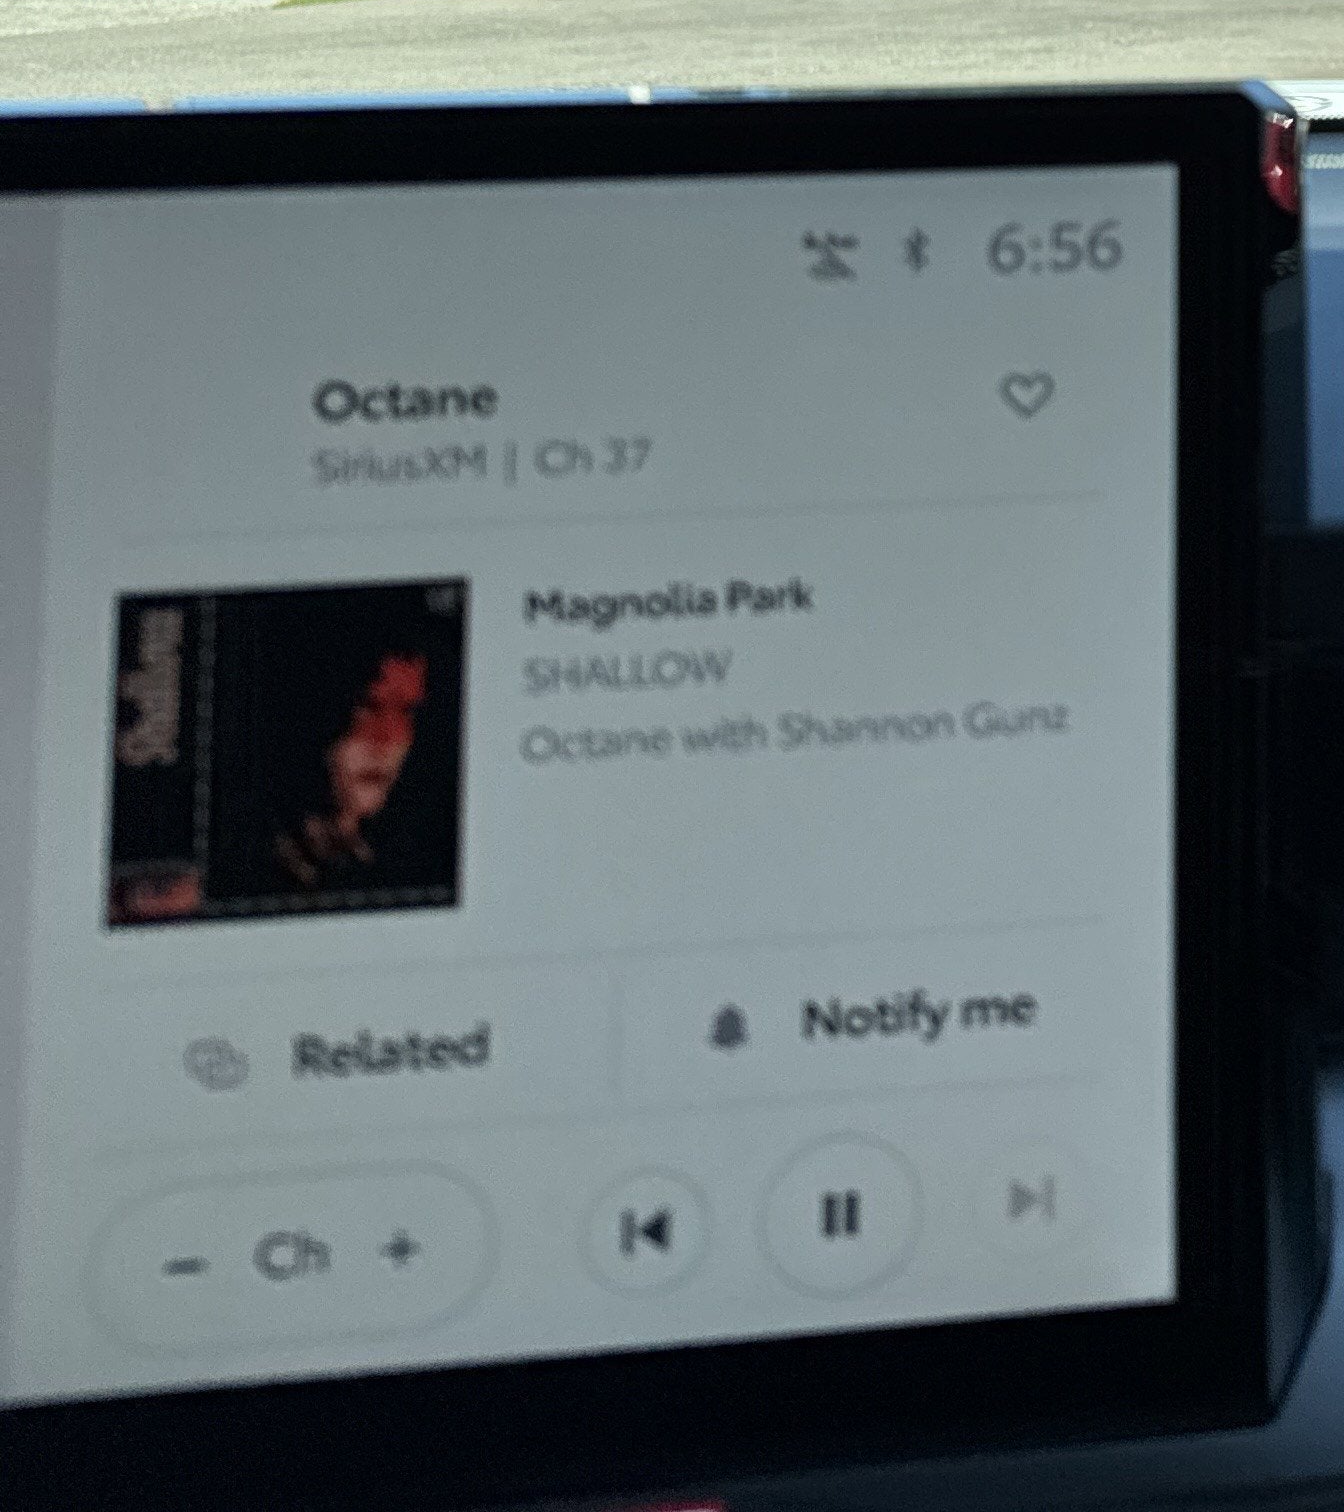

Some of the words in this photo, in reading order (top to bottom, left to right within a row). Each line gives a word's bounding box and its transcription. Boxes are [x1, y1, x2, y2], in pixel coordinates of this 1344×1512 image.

[987, 218, 1122, 276] 6:56
[312, 378, 499, 422] Octane
[310, 443, 486, 485] SiriusXM
[534, 436, 592, 477] Ch
[603, 436, 651, 474] 37
[522, 582, 717, 631] Magnolia
[726, 577, 814, 614] Park
[522, 649, 733, 694] SHALLOW
[520, 725, 673, 763] Octane
[681, 716, 767, 753] with
[777, 710, 955, 750] Shannon
[963, 701, 1070, 738] Gunz
[804, 988, 951, 1042] Notify
[961, 993, 1038, 1031] me
[291, 1022, 491, 1077] Related
[252, 1229, 333, 1282] Ch
